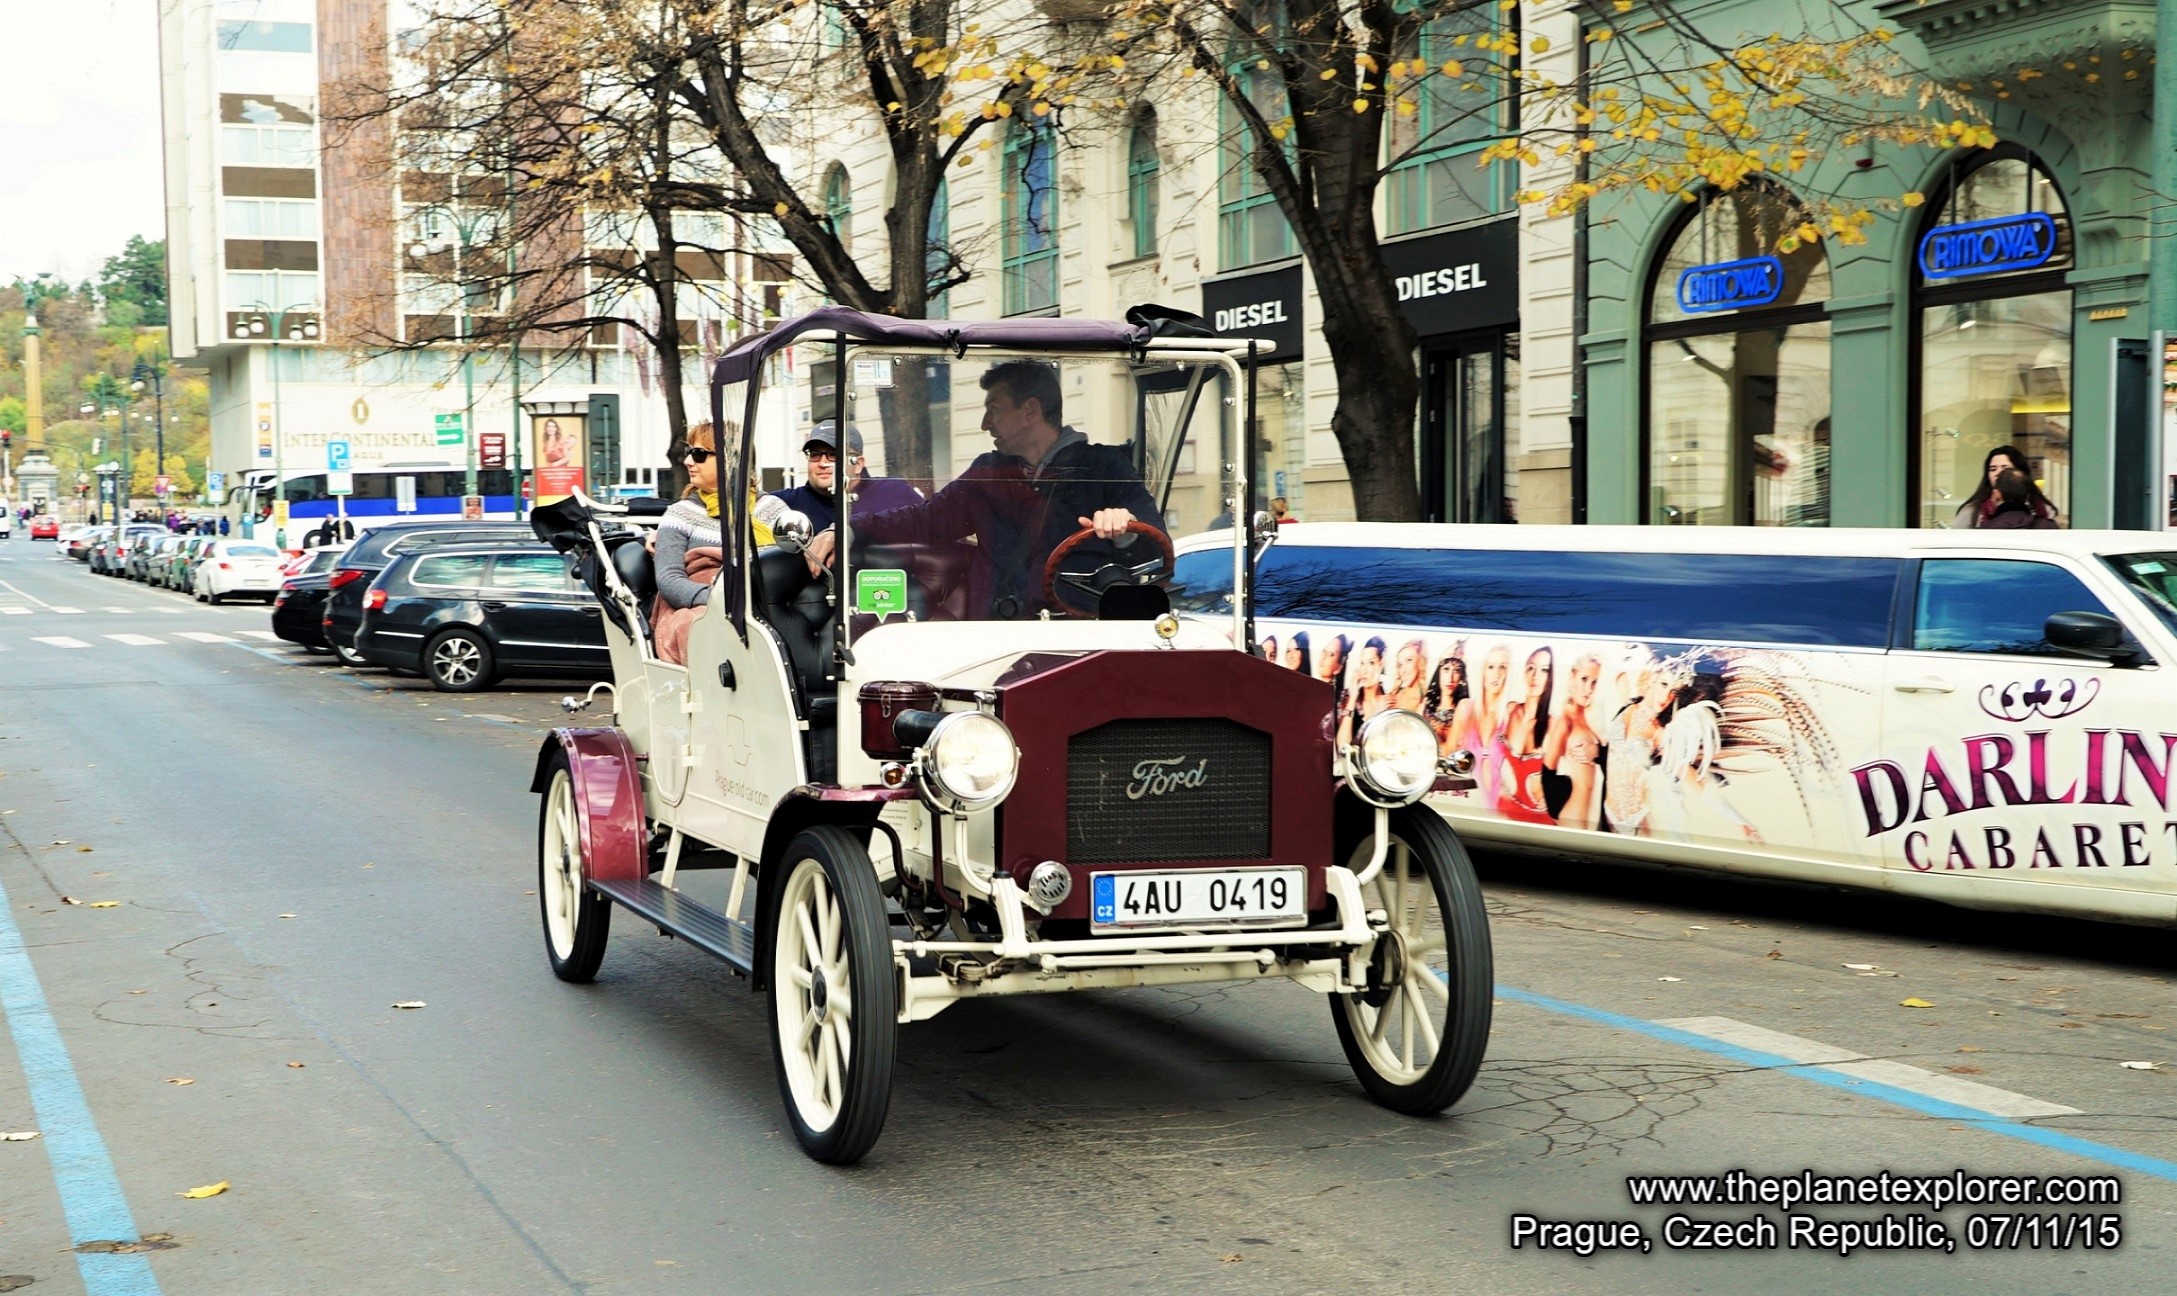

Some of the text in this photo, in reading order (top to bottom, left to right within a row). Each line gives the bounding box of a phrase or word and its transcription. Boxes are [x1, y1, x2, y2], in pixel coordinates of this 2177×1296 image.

[1934, 223, 2040, 269] RIMOWA
[1395, 263, 1487, 301] DIESEL
[1690, 265, 1771, 304] RIMOWA
[1215, 300, 1288, 332] DIESEL
[331, 444, 345, 462] P
[1126, 755, 1208, 800] Ford
[1097, 905, 1113, 917] CZ
[1123, 877, 1287, 915] 4AU 0419
